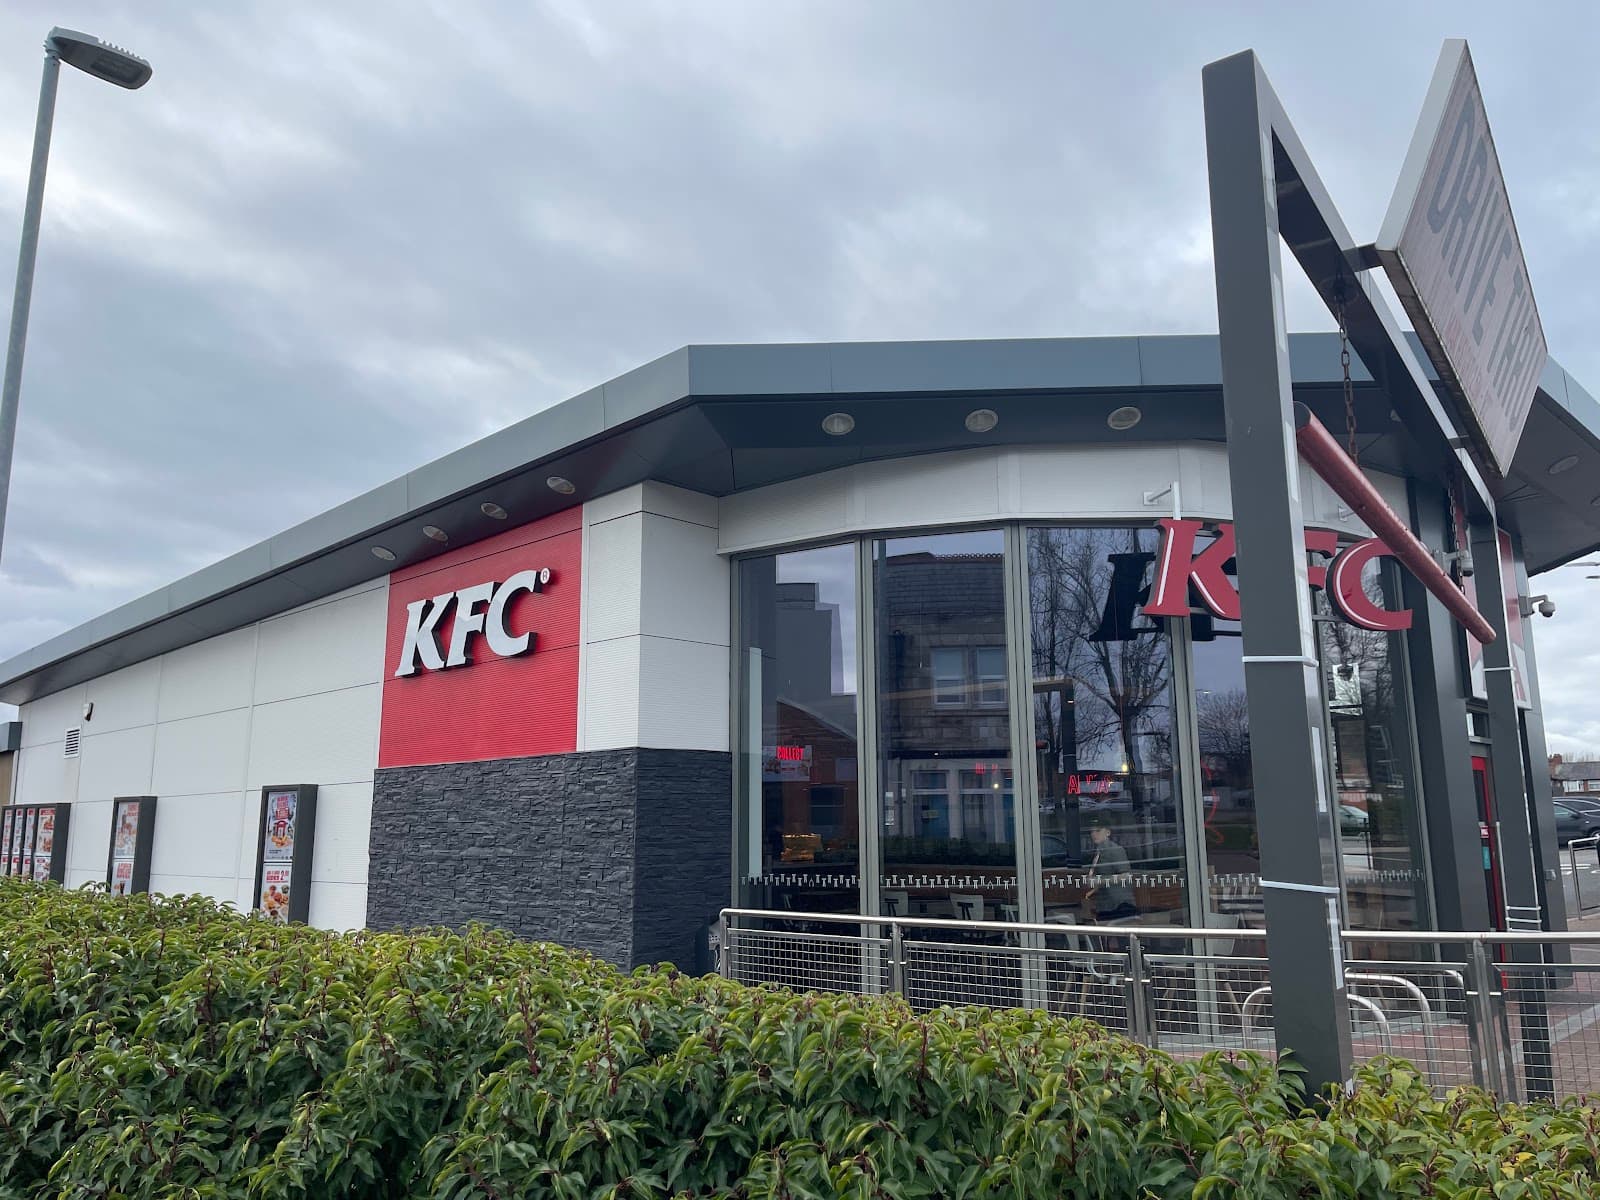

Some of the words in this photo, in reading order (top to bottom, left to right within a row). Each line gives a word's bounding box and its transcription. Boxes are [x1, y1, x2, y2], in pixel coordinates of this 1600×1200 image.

[1427, 89, 1512, 347] DRIVE
[1487, 262, 1542, 432] THRU
[777, 745, 805, 761] COLLECT
